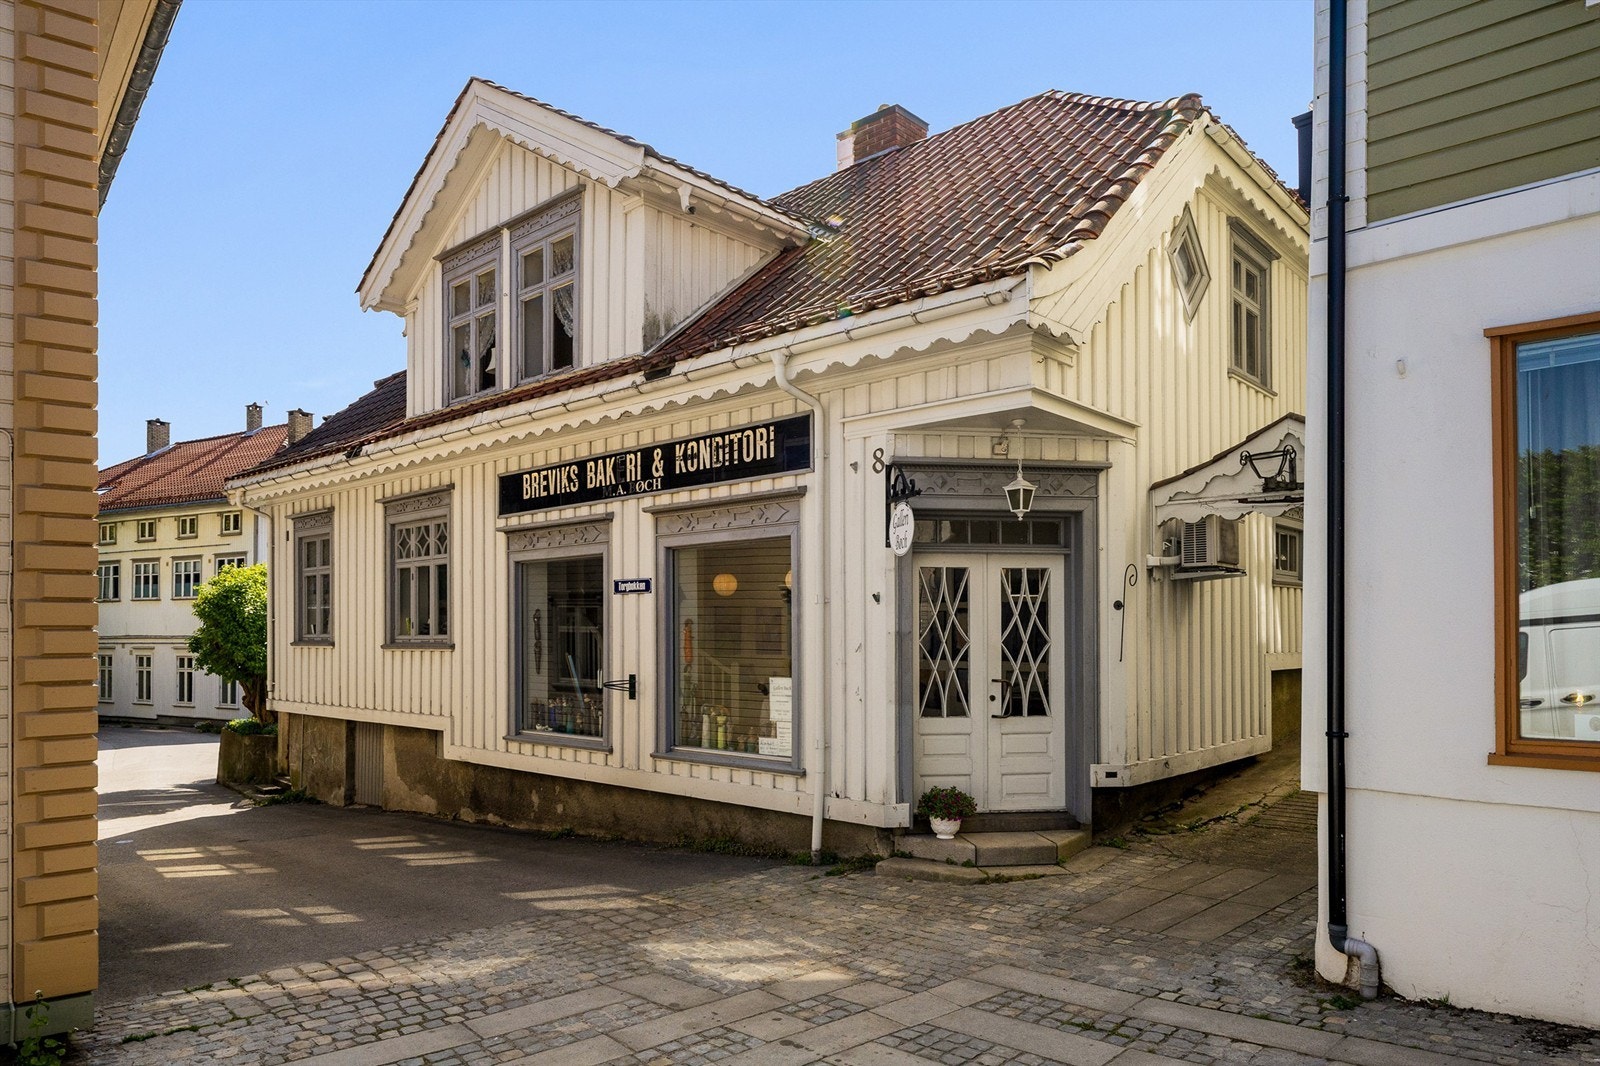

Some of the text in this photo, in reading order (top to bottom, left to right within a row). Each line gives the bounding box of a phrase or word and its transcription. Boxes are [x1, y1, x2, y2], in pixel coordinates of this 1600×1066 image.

[522, 464, 579, 500] BREVIKS
[651, 447, 664, 478] &
[675, 425, 775, 475] KONDITORI
[872, 447, 885, 474] 8
